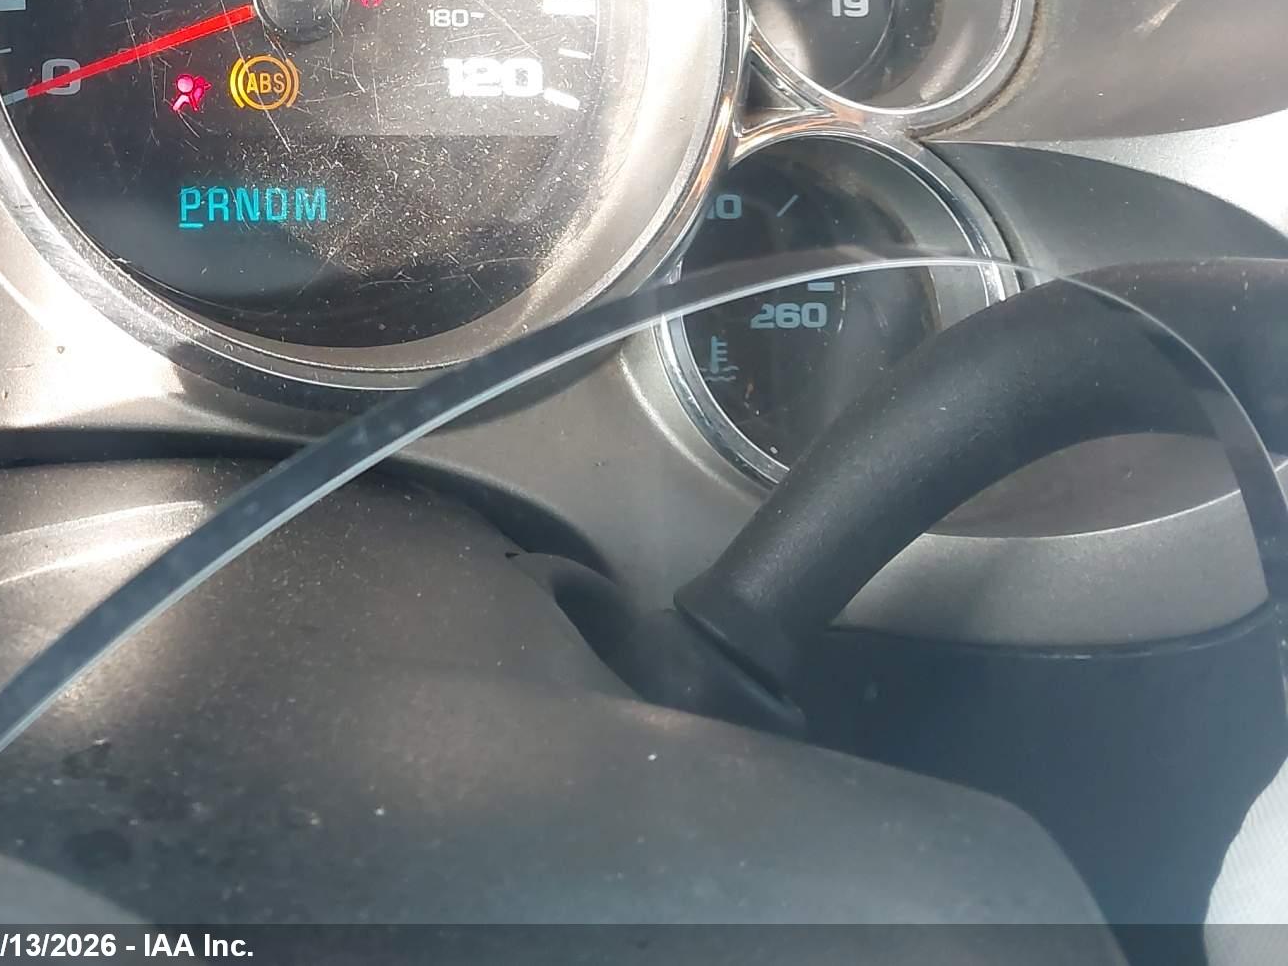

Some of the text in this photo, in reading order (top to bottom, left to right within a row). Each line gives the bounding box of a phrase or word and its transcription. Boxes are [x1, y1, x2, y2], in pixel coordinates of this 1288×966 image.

[427, 9, 469, 27] 180
[40, 59, 82, 96] 0
[246, 71, 287, 94] ABS
[446, 59, 543, 97] 120
[750, 301, 827, 328] 260
